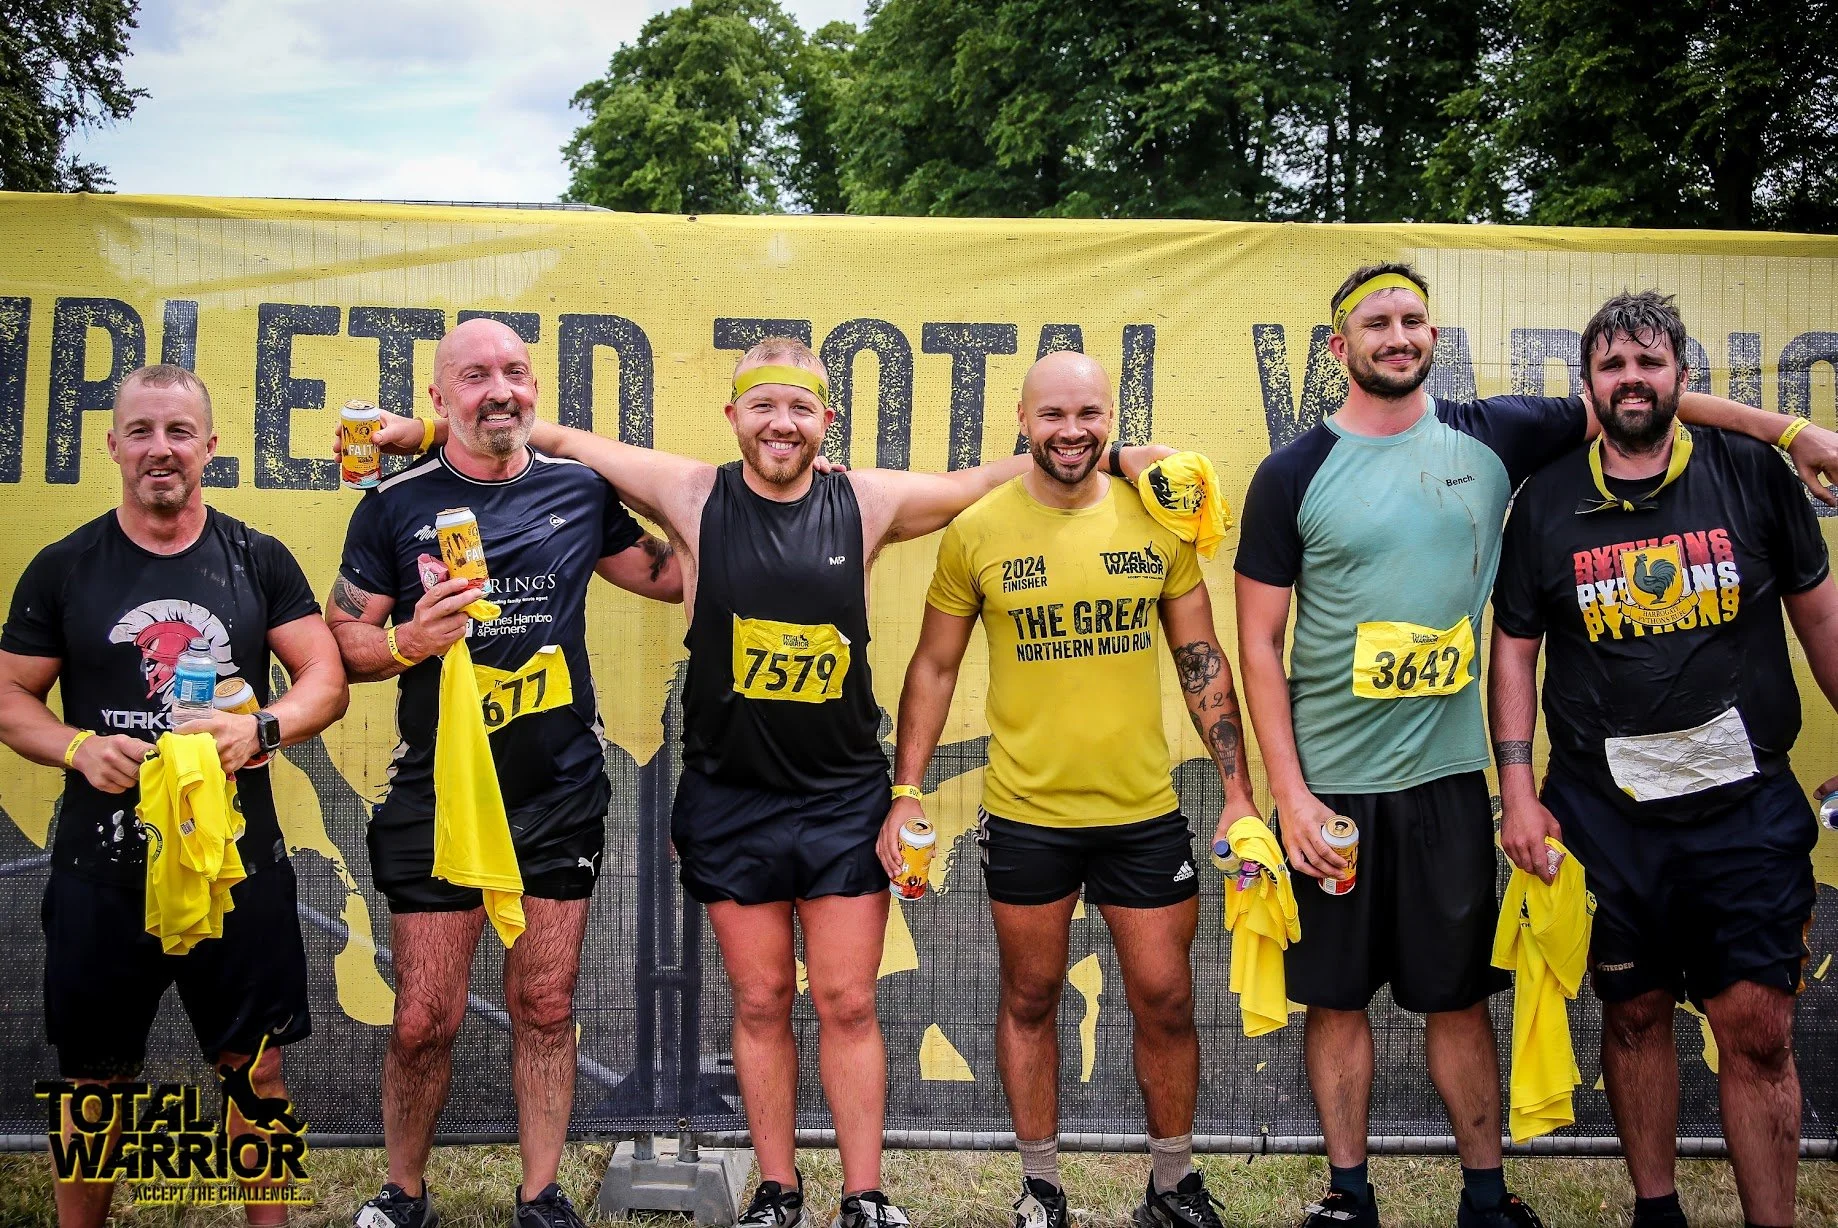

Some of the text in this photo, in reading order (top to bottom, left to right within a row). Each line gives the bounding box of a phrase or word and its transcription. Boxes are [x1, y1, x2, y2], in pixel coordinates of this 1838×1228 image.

[348, 444, 379, 456] FAITH
[1446, 475, 1475, 487] Bench.
[465, 546, 485, 562] FAI
[829, 556, 845, 565] MP
[1100, 551, 1147, 564] TOTAL
[1002, 555, 1046, 580] 2024
[1105, 562, 1164, 575] WARRIOR
[489, 574, 556, 594] RINGS
[1003, 575, 1048, 593] FINISHER
[1577, 561, 1740, 611] PYNS
[513, 613, 553, 625] Hambro
[1008, 603, 1067, 641] THE
[477, 625, 527, 638] &Partners
[1016, 631, 1152, 662] NORTHERN MUD RUN
[744, 647, 837, 695] 7579
[1372, 646, 1460, 690] 3642
[482, 668, 547, 726] 677
[101, 708, 173, 730] YORK
[1173, 870, 1195, 882] adidas
